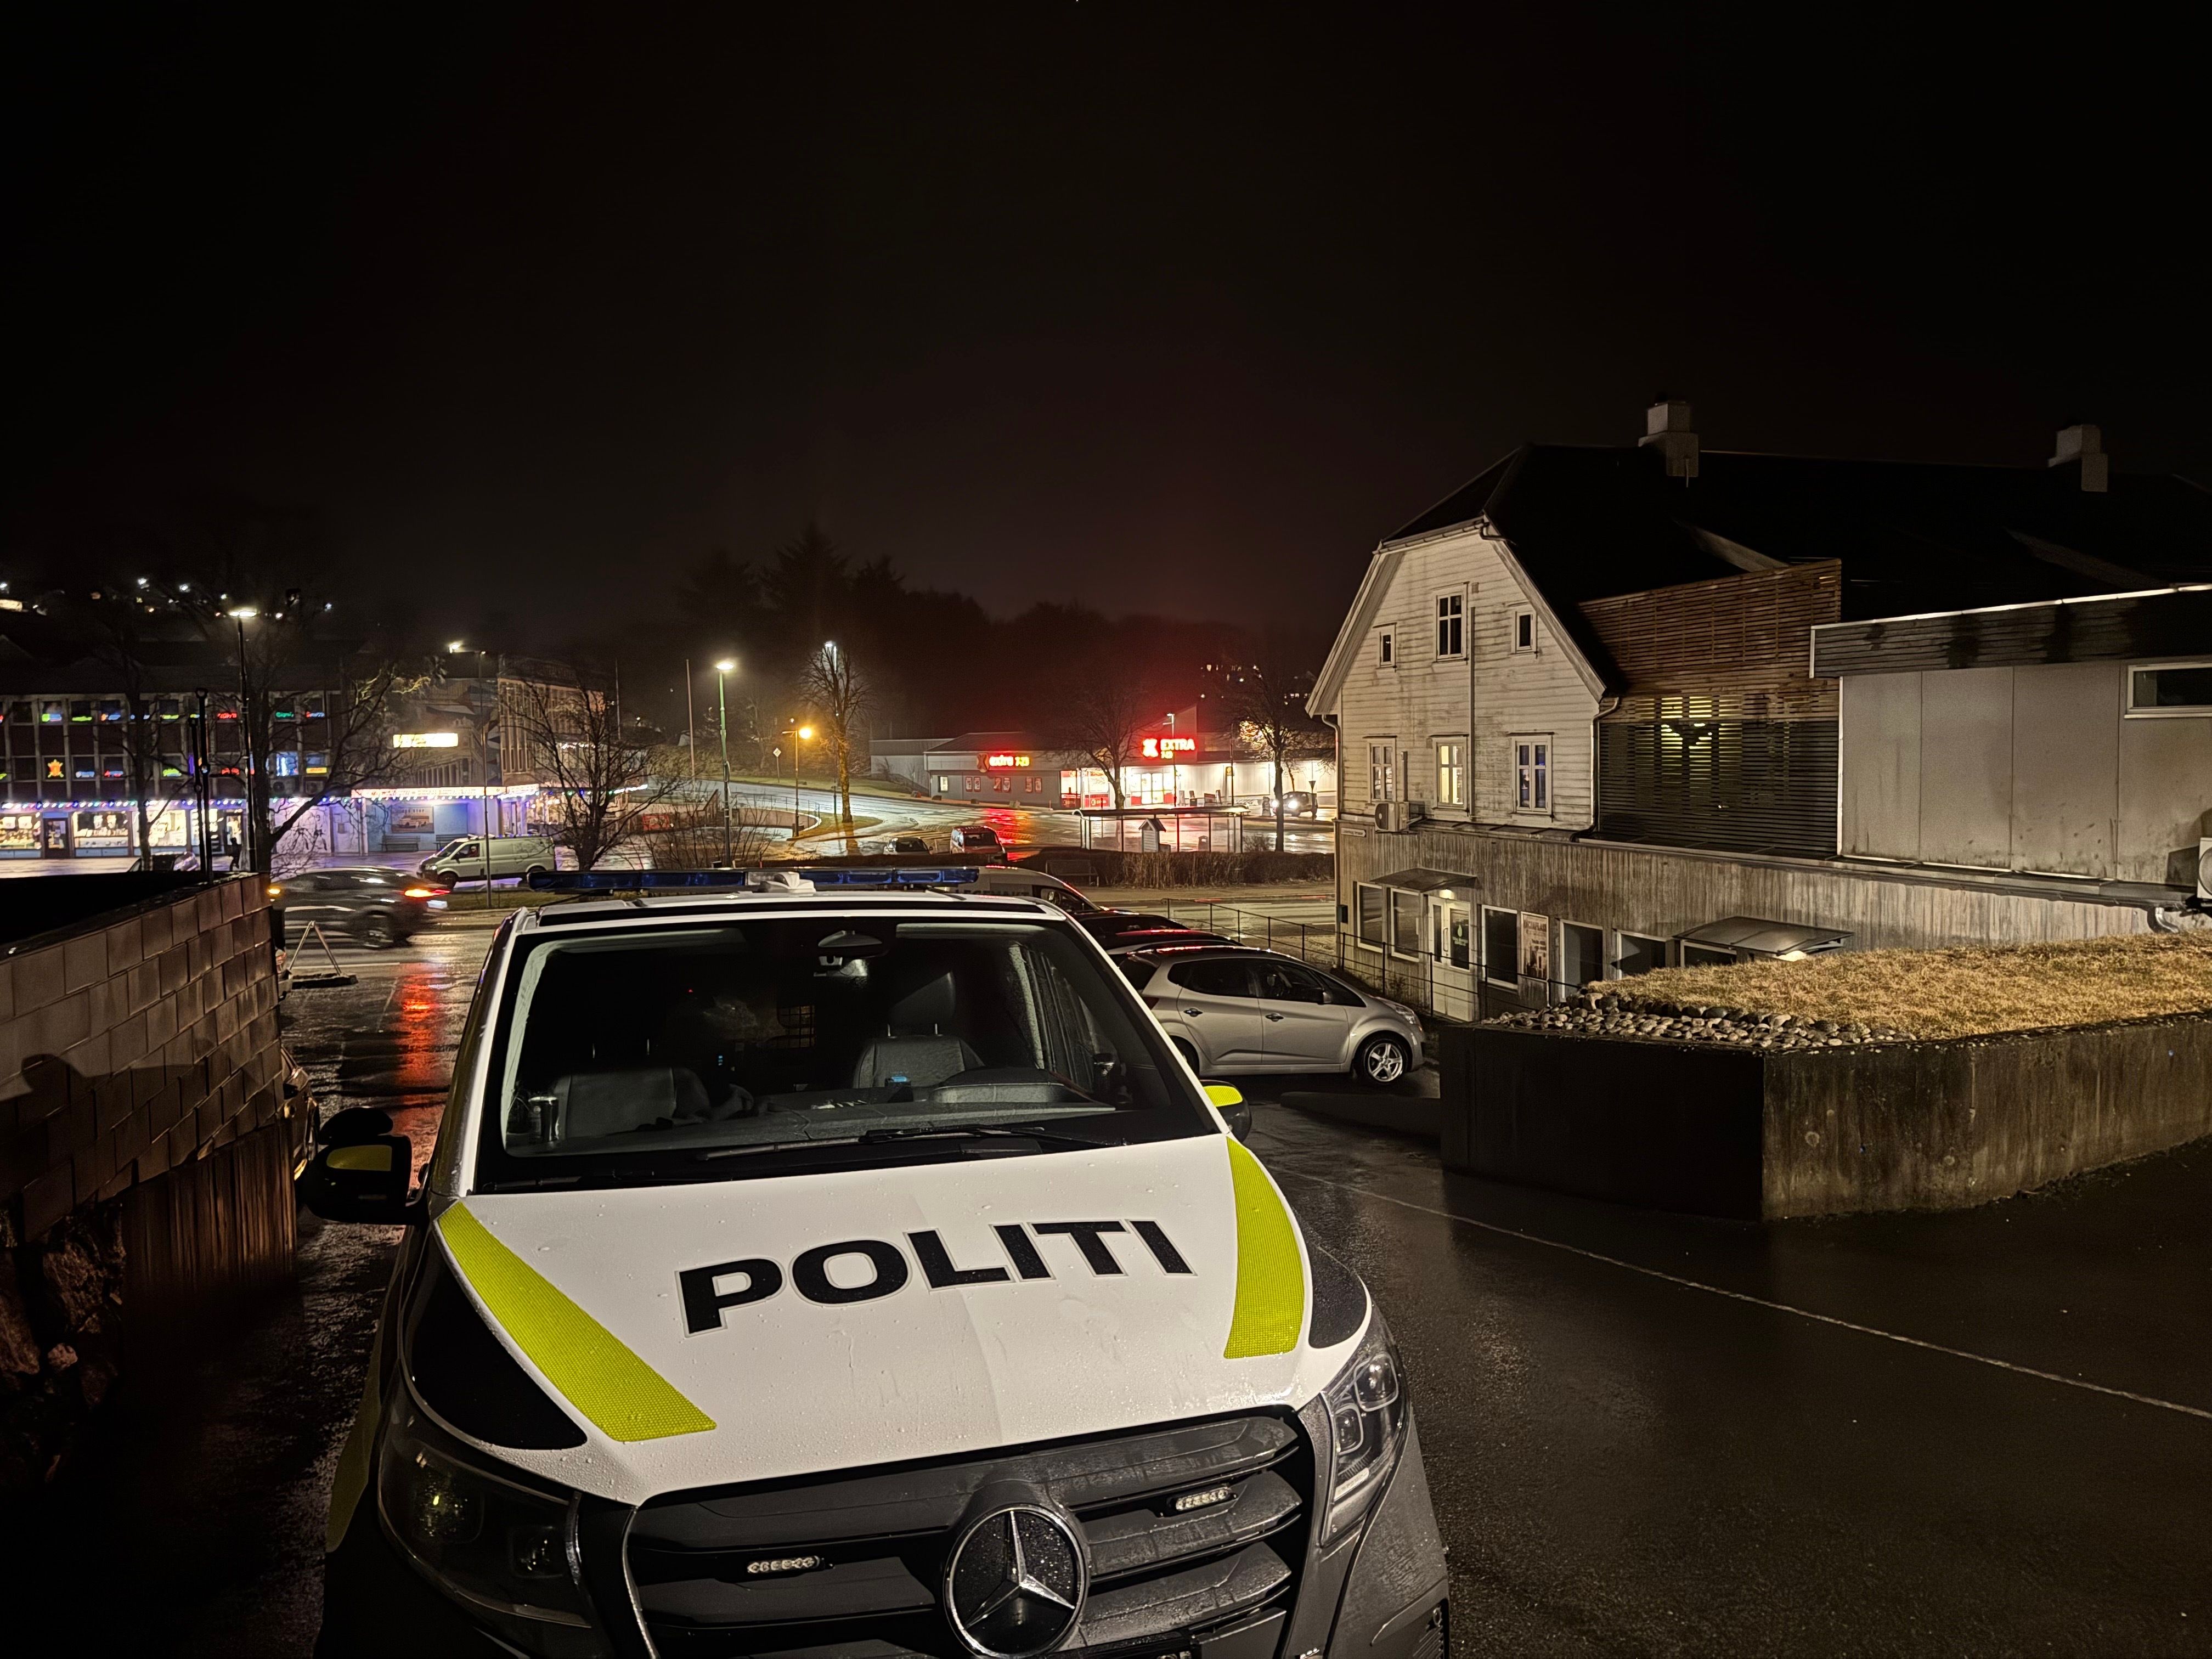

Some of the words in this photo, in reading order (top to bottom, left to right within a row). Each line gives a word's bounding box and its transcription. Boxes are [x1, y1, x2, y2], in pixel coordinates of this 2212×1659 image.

[1160, 738, 1195, 751] EXTRA
[989, 755, 1014, 766] extra
[679, 1221, 1193, 1334] POLITI
